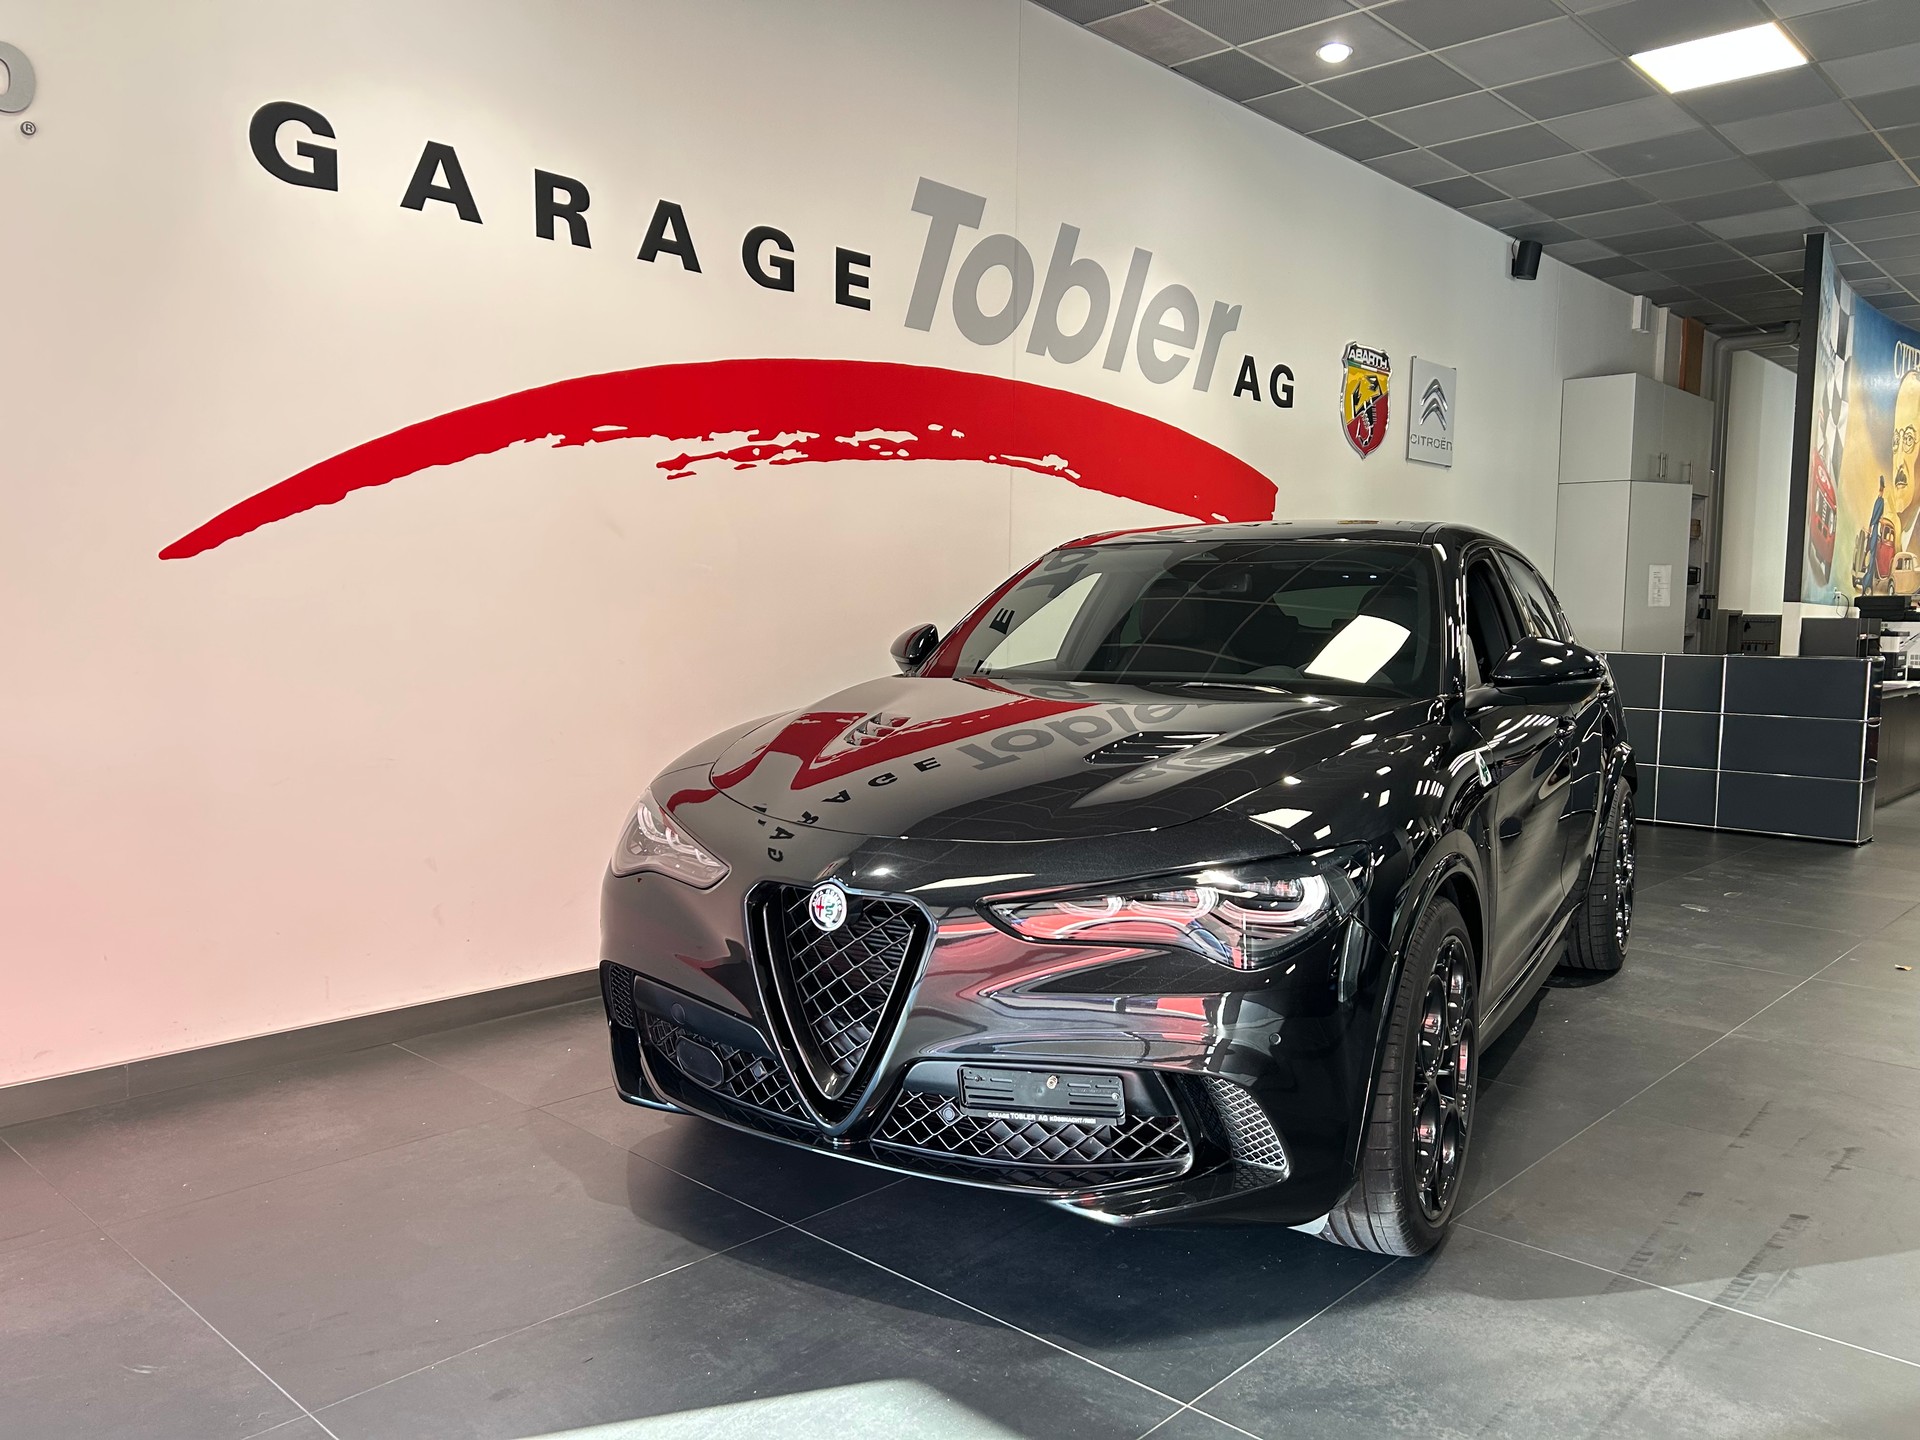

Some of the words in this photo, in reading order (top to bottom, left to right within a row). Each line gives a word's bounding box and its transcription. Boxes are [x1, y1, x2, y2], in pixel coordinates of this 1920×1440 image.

[249, 101, 872, 311] GARAGE
[903, 175, 1243, 393] Tobler
[1232, 354, 1296, 410] AG
[1348, 348, 1389, 371] ABARTH
[1410, 433, 1453, 452] CITROËN
[1010, 1112, 1036, 1121] TOBLER
